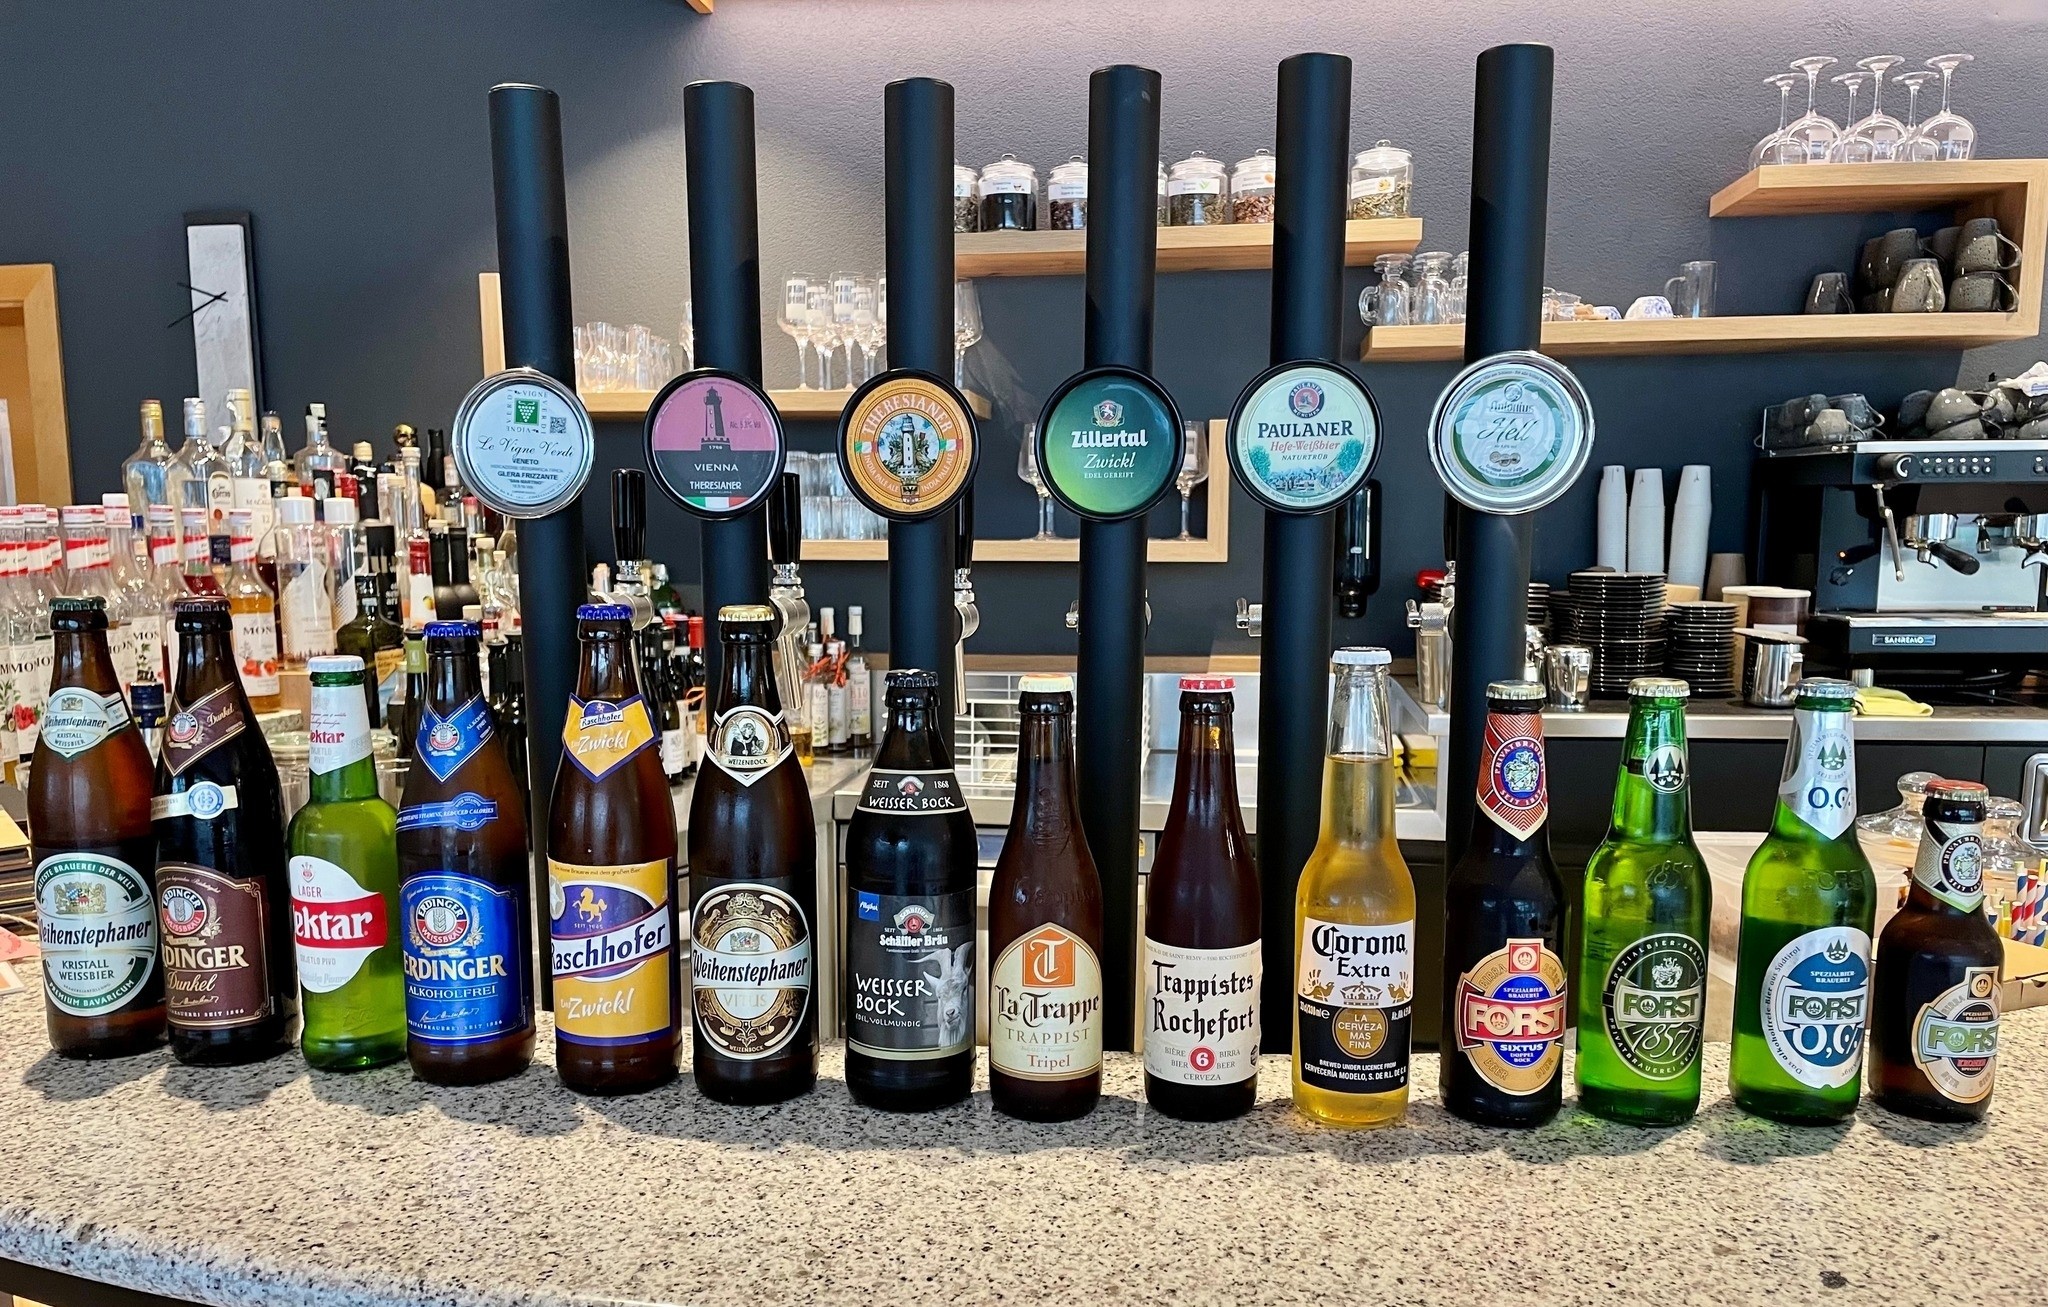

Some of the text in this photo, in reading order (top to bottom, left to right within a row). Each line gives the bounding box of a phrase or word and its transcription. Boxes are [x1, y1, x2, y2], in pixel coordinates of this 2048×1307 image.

[1290, 382, 1323, 397] PAULANER
[862, 394, 952, 436] THERESIANER
[1257, 420, 1354, 438] PAULANER
[1476, 418, 1540, 443] Hell
[1071, 429, 1149, 448] Zillertal
[1270, 440, 1341, 454] Hefe-Weißbier
[500, 437, 536, 461] Vigne
[539, 440, 574, 458] Verdi
[1281, 453, 1328, 461] NATURTRÜB
[512, 457, 539, 465] VENETO
[694, 463, 739, 472] VIENNA
[1083, 452, 1136, 469] Zwickl
[498, 470, 559, 481] GLERA FRIZZANTE
[863, 454, 900, 493] INDIA PALE ALE
[921, 452, 955, 492] INDIA PALE ALE
[690, 481, 742, 490] THERESIANER
[206, 702, 236, 727] Dunkel
[581, 713, 622, 727] Raschhofer
[54, 739, 86, 748] WEISSBIER
[310, 729, 345, 744] ektar
[576, 729, 632, 756] Zwickl
[728, 758, 768, 766] WEIZENBOCK
[1494, 740, 1545, 775] PRIVATBRAUEREI
[1817, 770, 1832, 780] SEIT
[873, 779, 950, 789] SEIT 1868
[868, 796, 955, 809] WEISSER BOCK
[1500, 789, 1520, 806] SEIT
[469, 807, 494, 815] CALORIES
[54, 862, 135, 891] BRAUEREI DER WELT
[1948, 878, 1967, 892] SEIT
[298, 886, 322, 898] LAGER
[418, 898, 464, 919] ERDINGER
[294, 906, 373, 940] ektar
[421, 925, 464, 944] WEISSBRÄU
[879, 934, 948, 947] Schäffler Bräu
[1312, 924, 1407, 961] Corona
[62, 959, 109, 970] KRISTALL
[403, 950, 508, 982] ERDINGER
[1337, 957, 1390, 978] Extra
[1775, 946, 1801, 972] Südtirol
[58, 970, 115, 981] WEISSBIER
[693, 950, 808, 987] Weihenstephaner
[1479, 963, 1507, 989] BIRRA
[167, 971, 218, 992] Dunkel
[855, 972, 933, 997] WEISSER
[1151, 960, 1253, 1004] Trappistes
[49, 979, 135, 1007] PREMIUM BAVARICUM
[408, 985, 496, 999] ALKOHOLFREI
[567, 988, 636, 1020] Zwickl
[856, 993, 905, 1017] BOCK
[995, 985, 1099, 1028] La Trappe
[1623, 992, 1700, 1019] FORST
[1788, 993, 1865, 1020] FORST
[1942, 994, 1966, 1015] BIRRA
[870, 1015, 921, 1027] VOLLMUNDIG
[1152, 997, 1254, 1042] Rochefort
[1338, 1022, 1383, 1031] CERVEZA
[1354, 1014, 1368, 1022] LA
[1467, 1000, 1564, 1036] FORST
[1005, 1027, 1091, 1044] TRAPPIST
[1349, 1032, 1371, 1040] MAS
[1631, 1022, 1693, 1059] 1857
[1767, 1008, 1788, 1061] alkoholfreie
[1927, 1024, 1997, 1053] FORS
[729, 1044, 764, 1053] WEIZENBOCK
[1164, 1046, 1186, 1057] BIÈRE
[1348, 1040, 1372, 1049] FINA
[1500, 1043, 1544, 1052] SIXTUS
[1609, 1017, 1676, 1074] PRIVATBRAUEREI
[1195, 1052, 1210, 1067] 6
[1219, 1049, 1241, 1058] BIRRA
[1027, 1054, 1070, 1071] Tripel
[1171, 1059, 1189, 1069] BIER
[1216, 1061, 1236, 1070] BEER
[1319, 1059, 1397, 1071] BREWED UNDER LICENCE FROM
[1483, 1058, 1509, 1081] BEER
[1788, 1061, 1803, 1075] Das
[1183, 1073, 1222, 1081] CERVEZA
[1304, 1062, 1338, 1078] CERVECERÍA
[1338, 1071, 1368, 1081] MODELO,
[1368, 1072, 1375, 1080] S.
[1375, 1071, 1383, 1080] DE
[1394, 1068, 1400, 1077] DE
[1978, 1072, 1991, 1088] BIER
[1941, 1071, 1960, 1090] BEER
